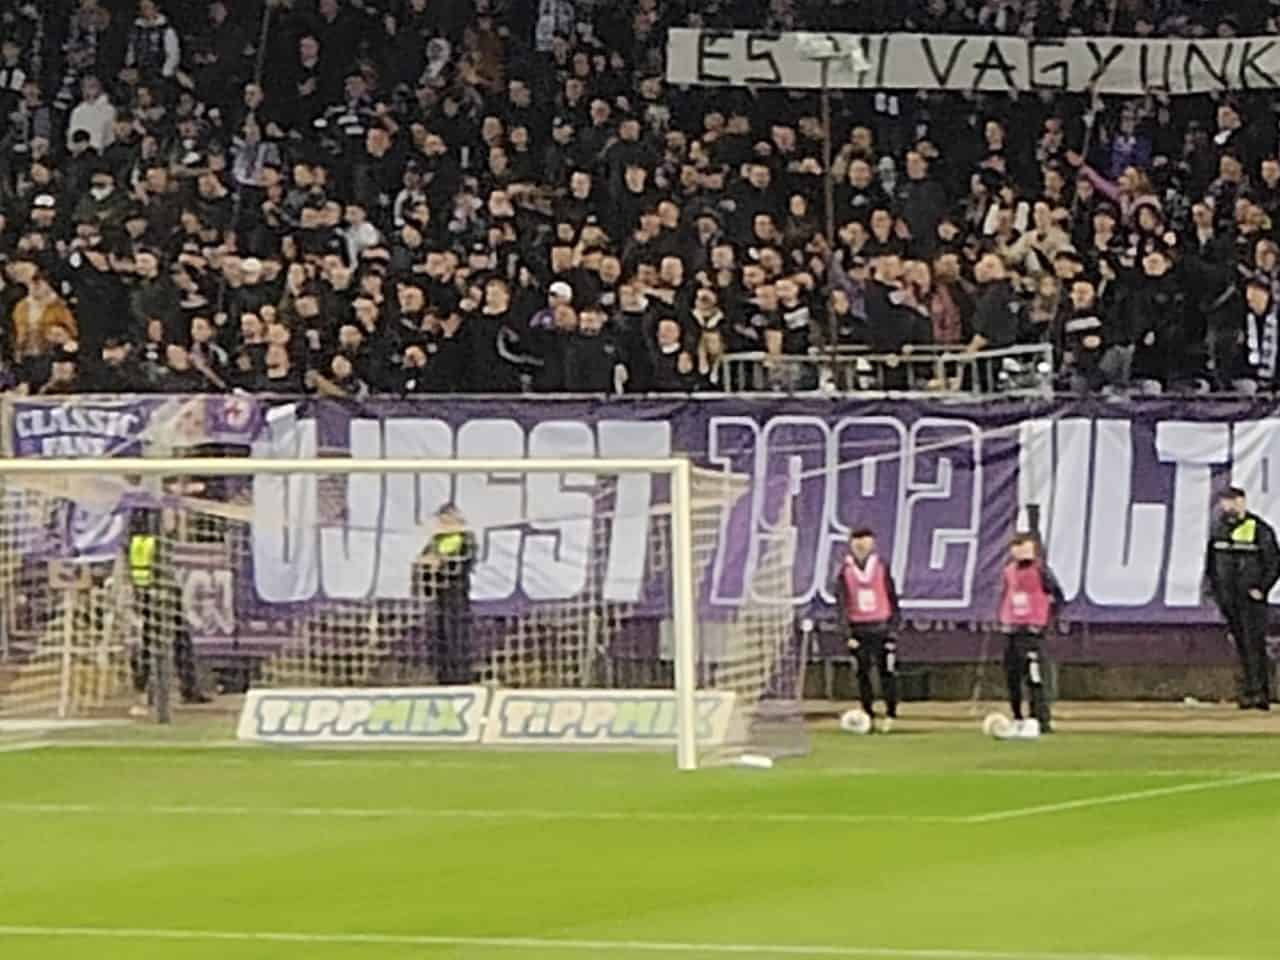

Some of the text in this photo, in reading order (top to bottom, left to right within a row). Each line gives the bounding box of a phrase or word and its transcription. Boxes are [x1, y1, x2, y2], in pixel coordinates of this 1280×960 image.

[921, 36, 1277, 96] VAGYUNK
[15, 405, 141, 439] CLASSIC
[252, 417, 672, 603] UJPEST
